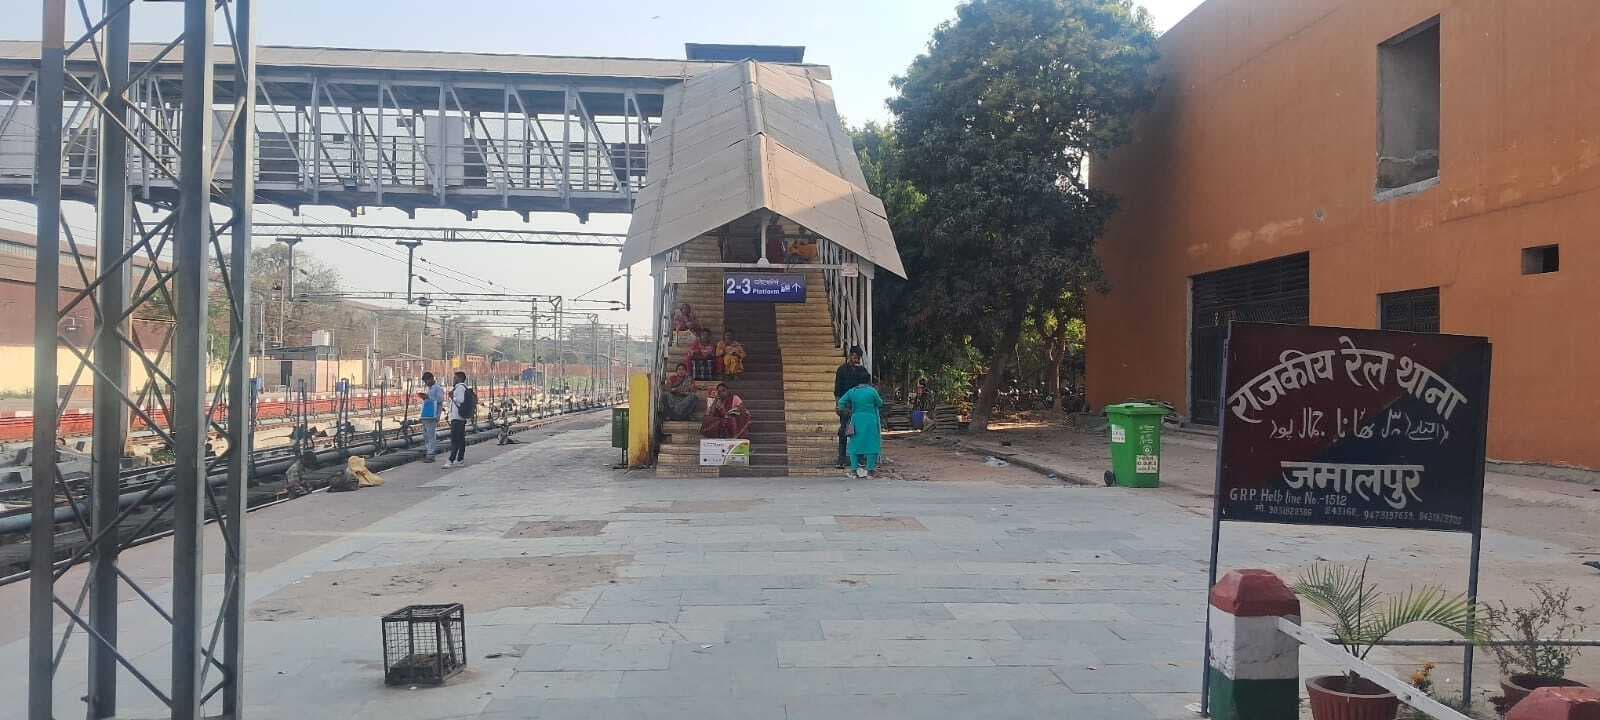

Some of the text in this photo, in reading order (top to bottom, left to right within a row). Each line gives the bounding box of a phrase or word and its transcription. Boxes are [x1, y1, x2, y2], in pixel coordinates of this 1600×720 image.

[726, 277, 751, 295] 2-3
[1227, 335, 1468, 423] राजकीय रेल थाना
[1261, 487, 1284, 505] Help
[1279, 460, 1425, 510] जमालपुर
